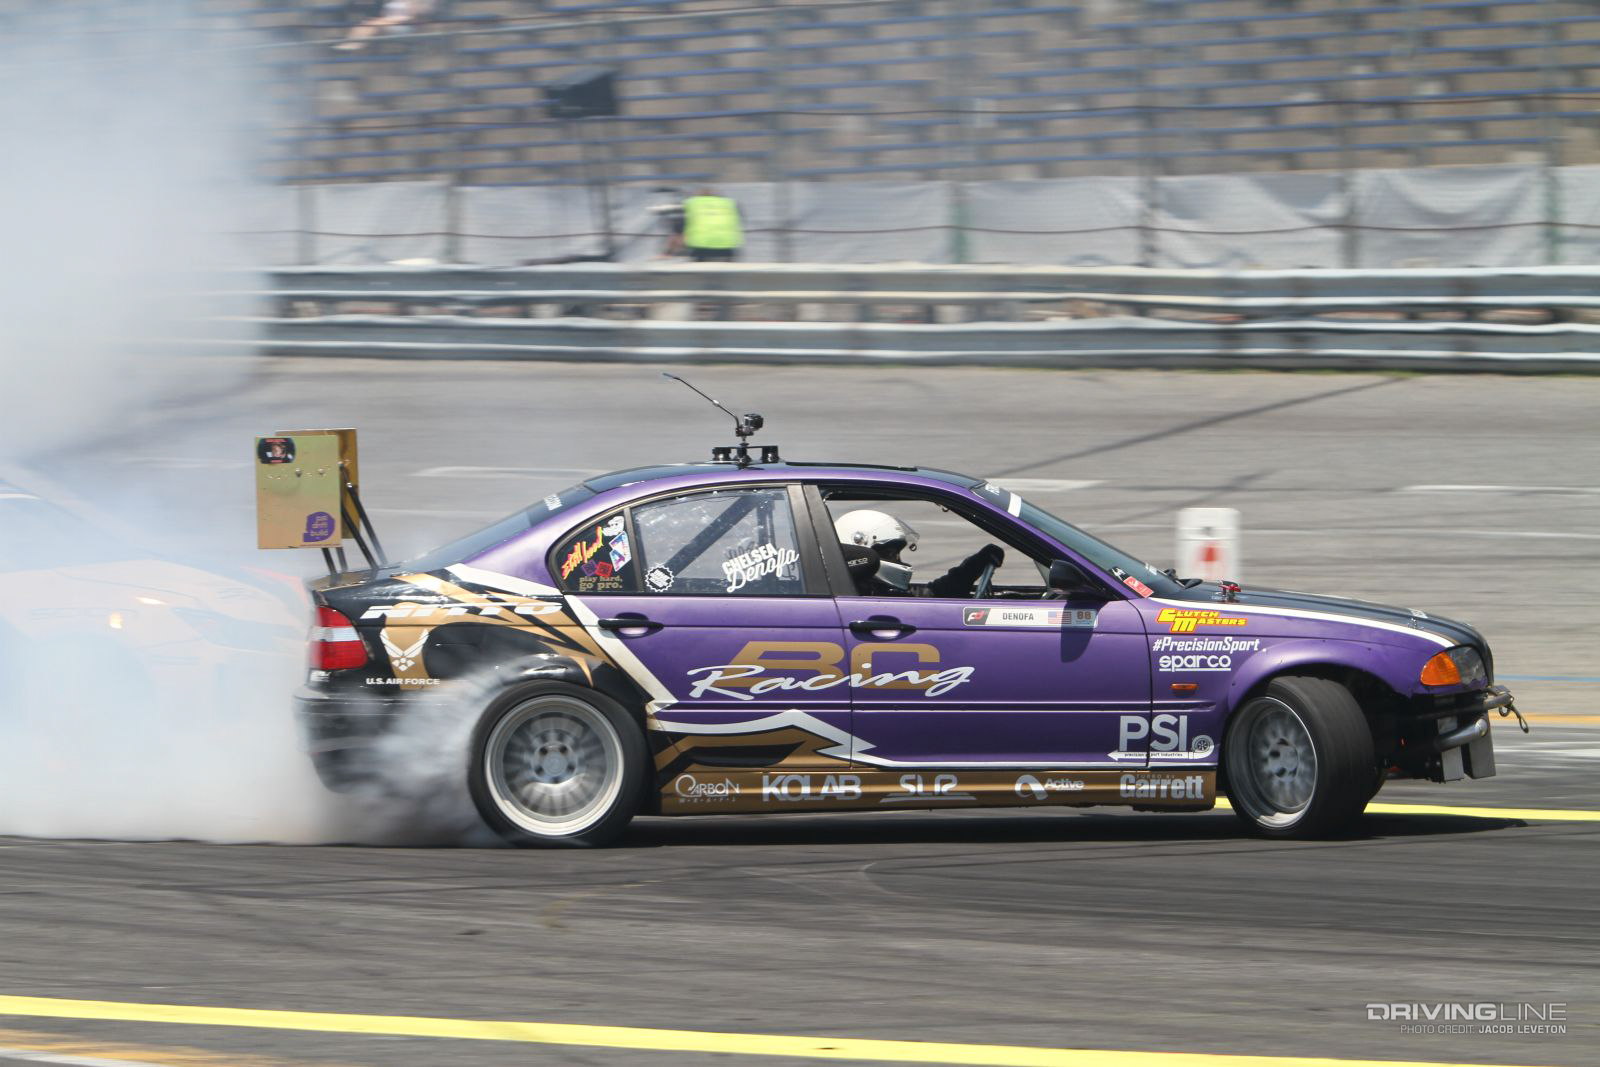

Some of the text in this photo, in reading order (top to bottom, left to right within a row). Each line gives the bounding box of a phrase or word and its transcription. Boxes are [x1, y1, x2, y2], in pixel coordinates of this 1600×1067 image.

[722, 542, 778, 575] CHELSEA
[726, 548, 799, 593] Denofa
[580, 576, 598, 584] play
[580, 582, 594, 592] go
[360, 602, 563, 619] NITTO
[1002, 612, 1034, 621] DENOFA
[1157, 608, 1219, 623] CLUTCH
[1170, 617, 1247, 633] MASTERS
[1159, 655, 1232, 672] sparco
[687, 664, 975, 701] Racing
[1119, 714, 1188, 752] PSI
[762, 775, 862, 802] KOLAB
[1045, 778, 1084, 789] Active
[1120, 774, 1204, 799] Garrett
